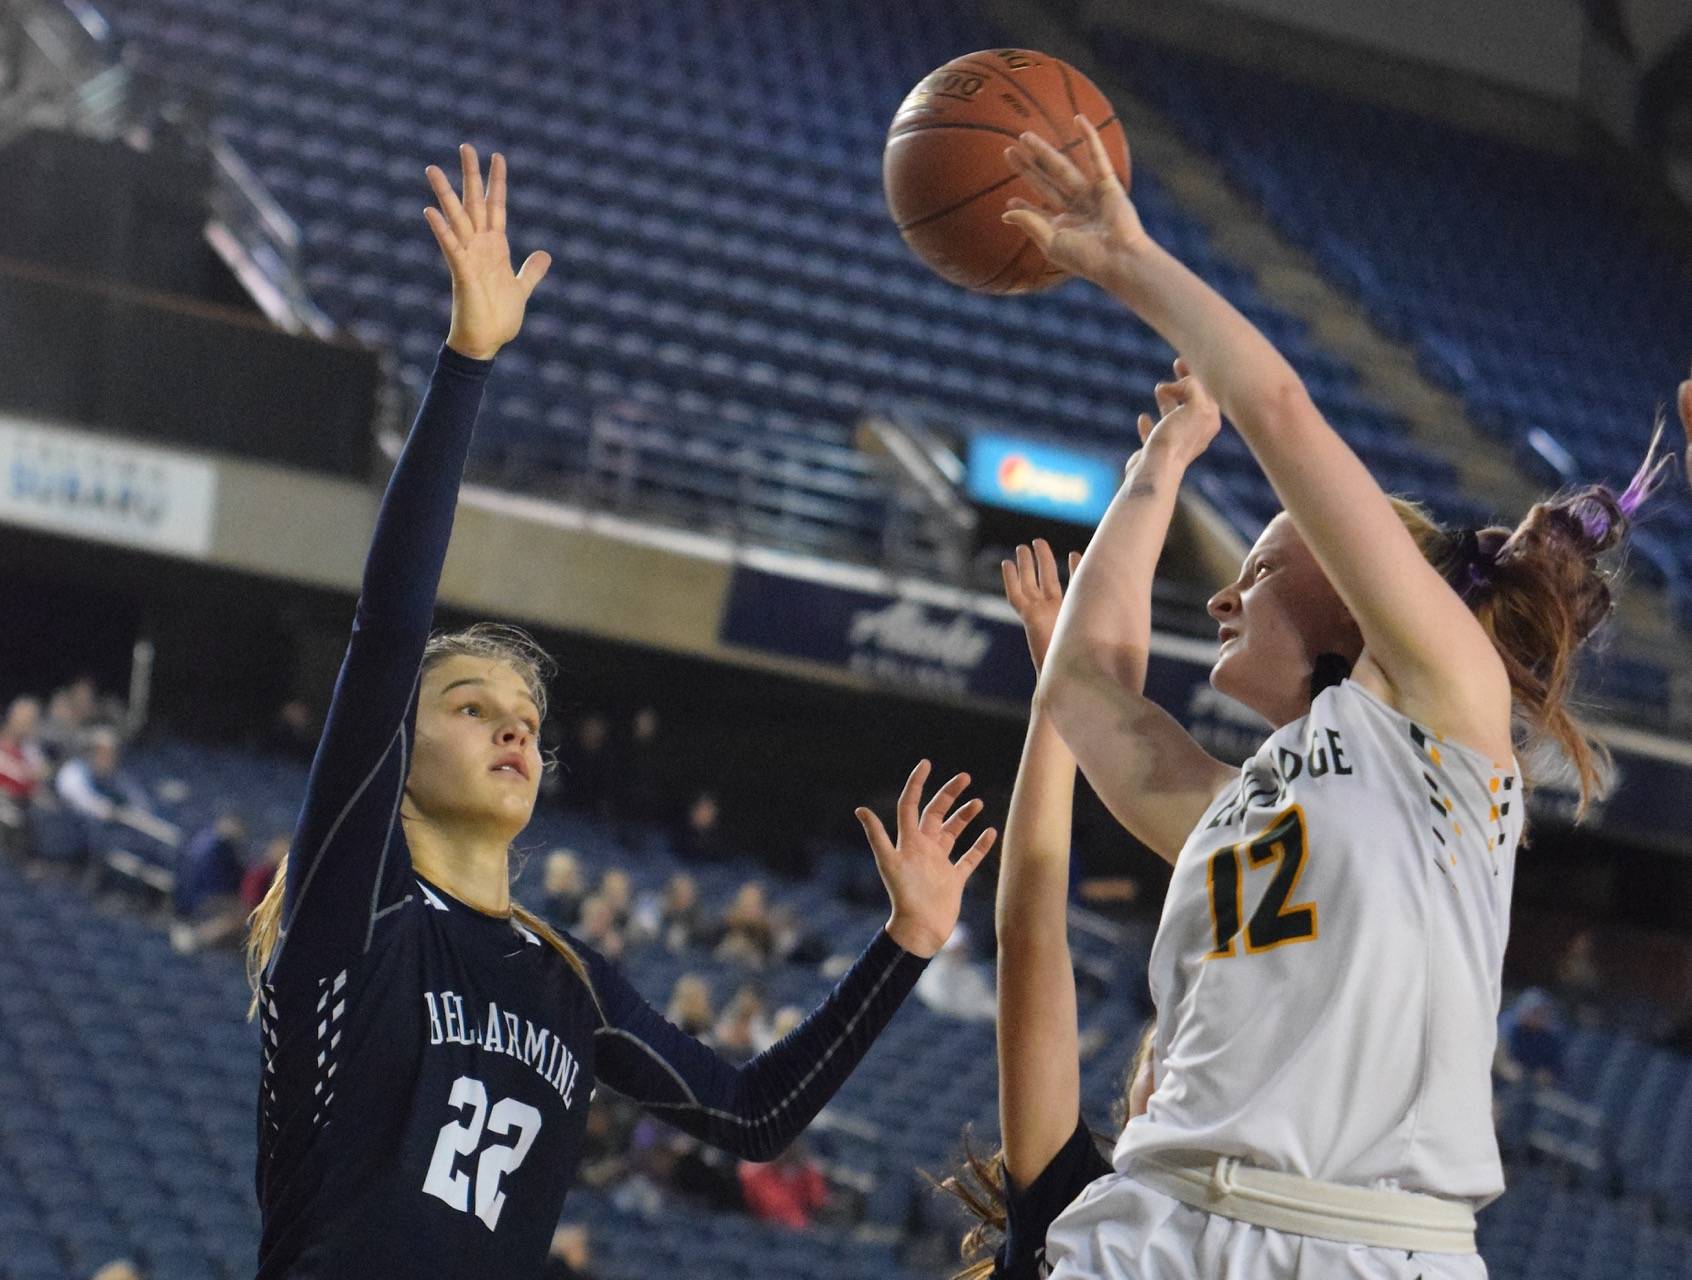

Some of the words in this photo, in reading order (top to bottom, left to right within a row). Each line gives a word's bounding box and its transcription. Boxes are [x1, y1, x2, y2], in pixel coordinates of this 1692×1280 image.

[1206, 803, 1319, 961] 12
[424, 990, 580, 1111] BELARMINE
[421, 1074, 543, 1233] 22
